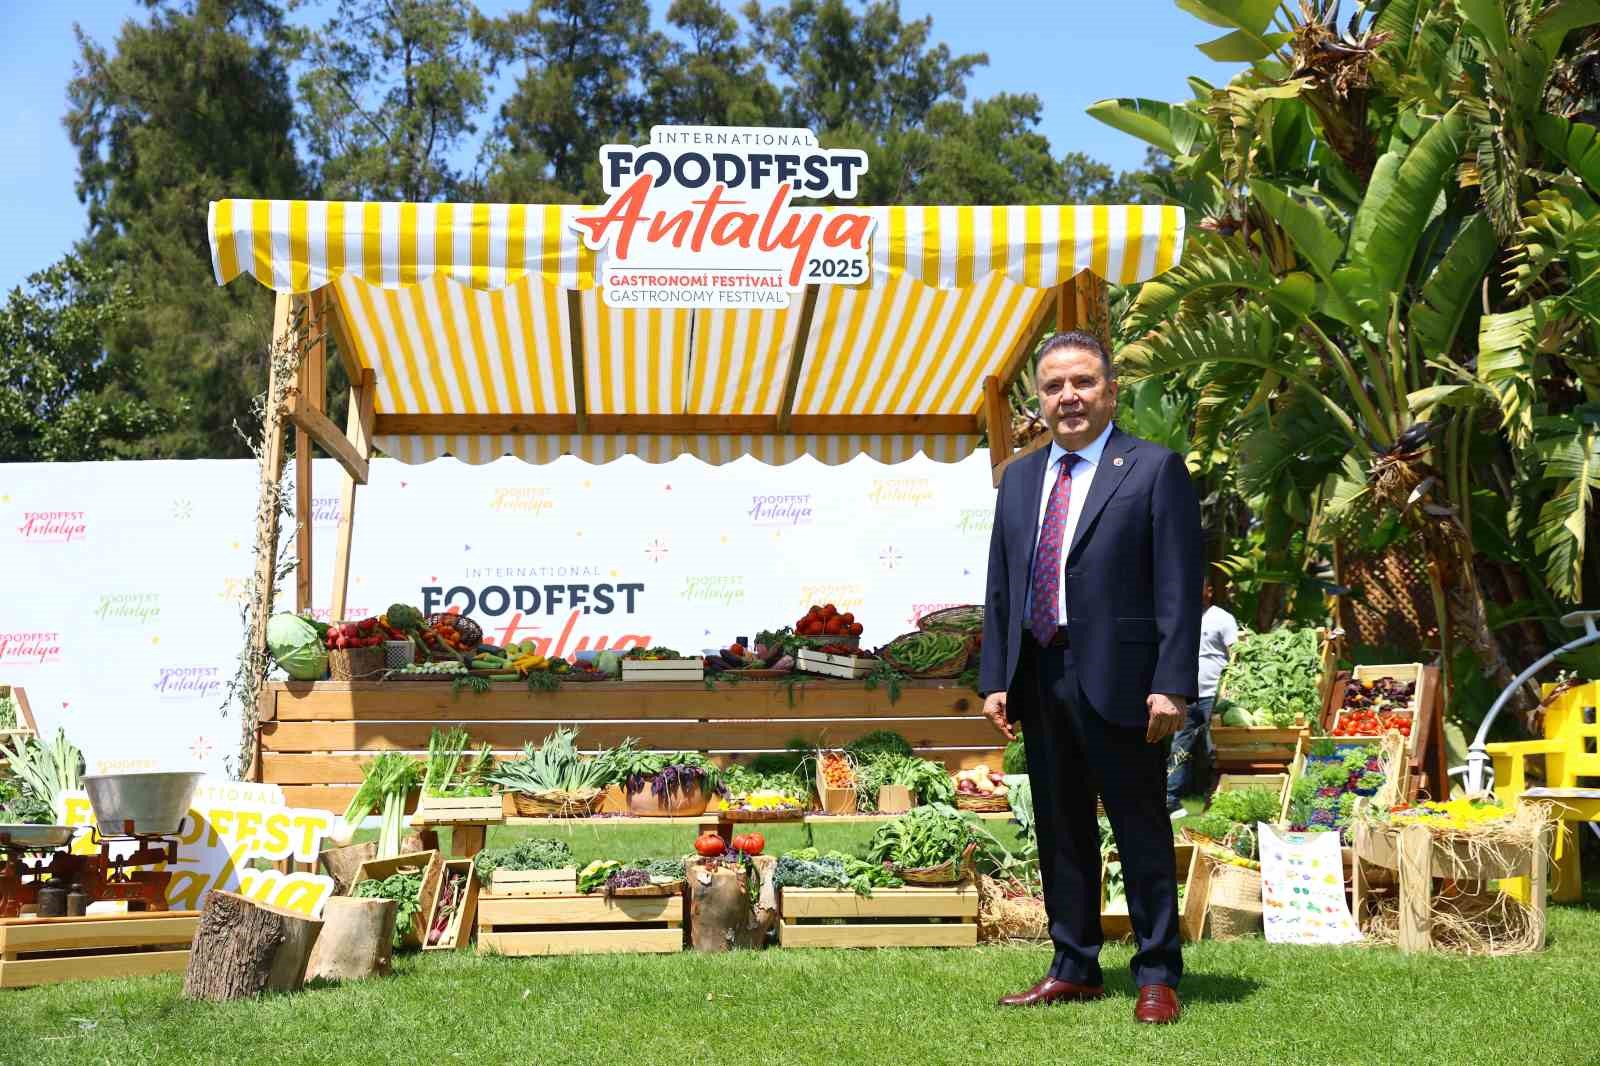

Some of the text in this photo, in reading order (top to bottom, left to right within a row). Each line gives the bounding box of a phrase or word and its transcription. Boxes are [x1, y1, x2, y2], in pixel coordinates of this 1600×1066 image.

[658, 131, 813, 146] INTERNATIONAL
[607, 151, 863, 192] FOODFEST
[575, 174, 871, 287] Antalya
[808, 258, 864, 278] 2025
[609, 289, 784, 304] GASTRONOMY FESTIVAL
[24, 511, 87, 520] FOODFEST
[747, 501, 812, 526] Antalya
[17, 519, 87, 543] Antalya
[465, 567, 601, 578] INTERNATIONAL
[421, 583, 645, 616] FOODFEST
[153, 673, 221, 698] Antalya
